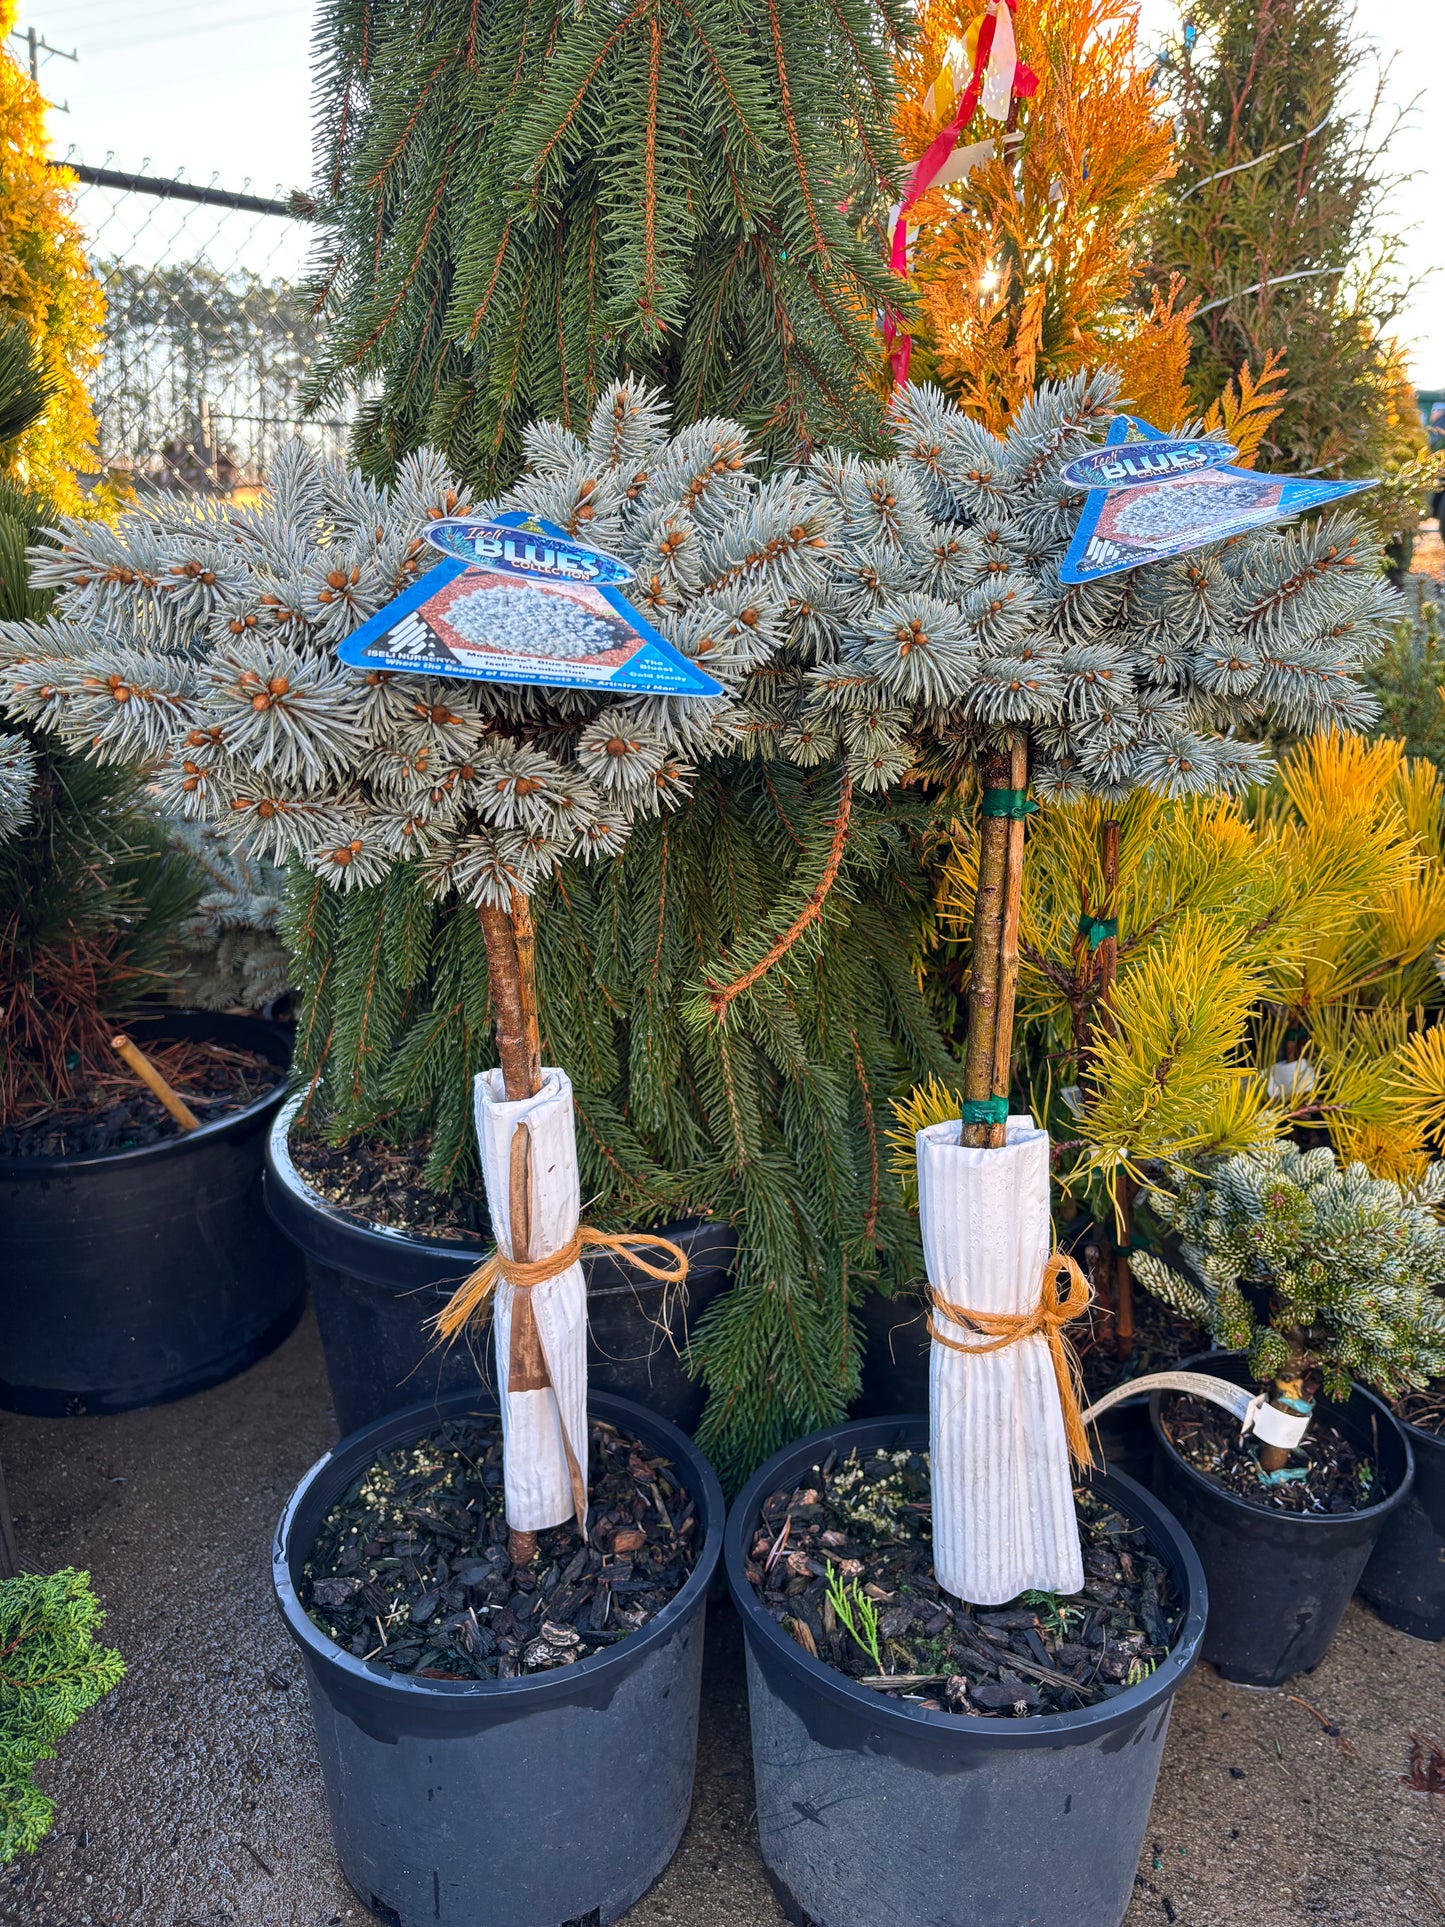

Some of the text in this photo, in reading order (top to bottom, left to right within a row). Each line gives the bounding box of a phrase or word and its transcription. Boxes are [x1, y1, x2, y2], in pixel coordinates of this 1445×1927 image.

[1101, 448, 1208, 480] BLUES
[1137, 461, 1204, 479] COLLECTION
[474, 538, 600, 577] BLUES
[511, 560, 591, 581] COLLECTION
[367, 649, 453, 664] ISELI NURSERY
[385, 658, 421, 668] Where
[423, 662, 442, 671] the
[444, 664, 479, 677] Beauty
[485, 669, 498, 677] of
[499, 670, 536, 680] Nature
[538, 673, 572, 683] Meets
[597, 681, 638, 689] Artistry
[518, 664, 585, 675] Introduction
